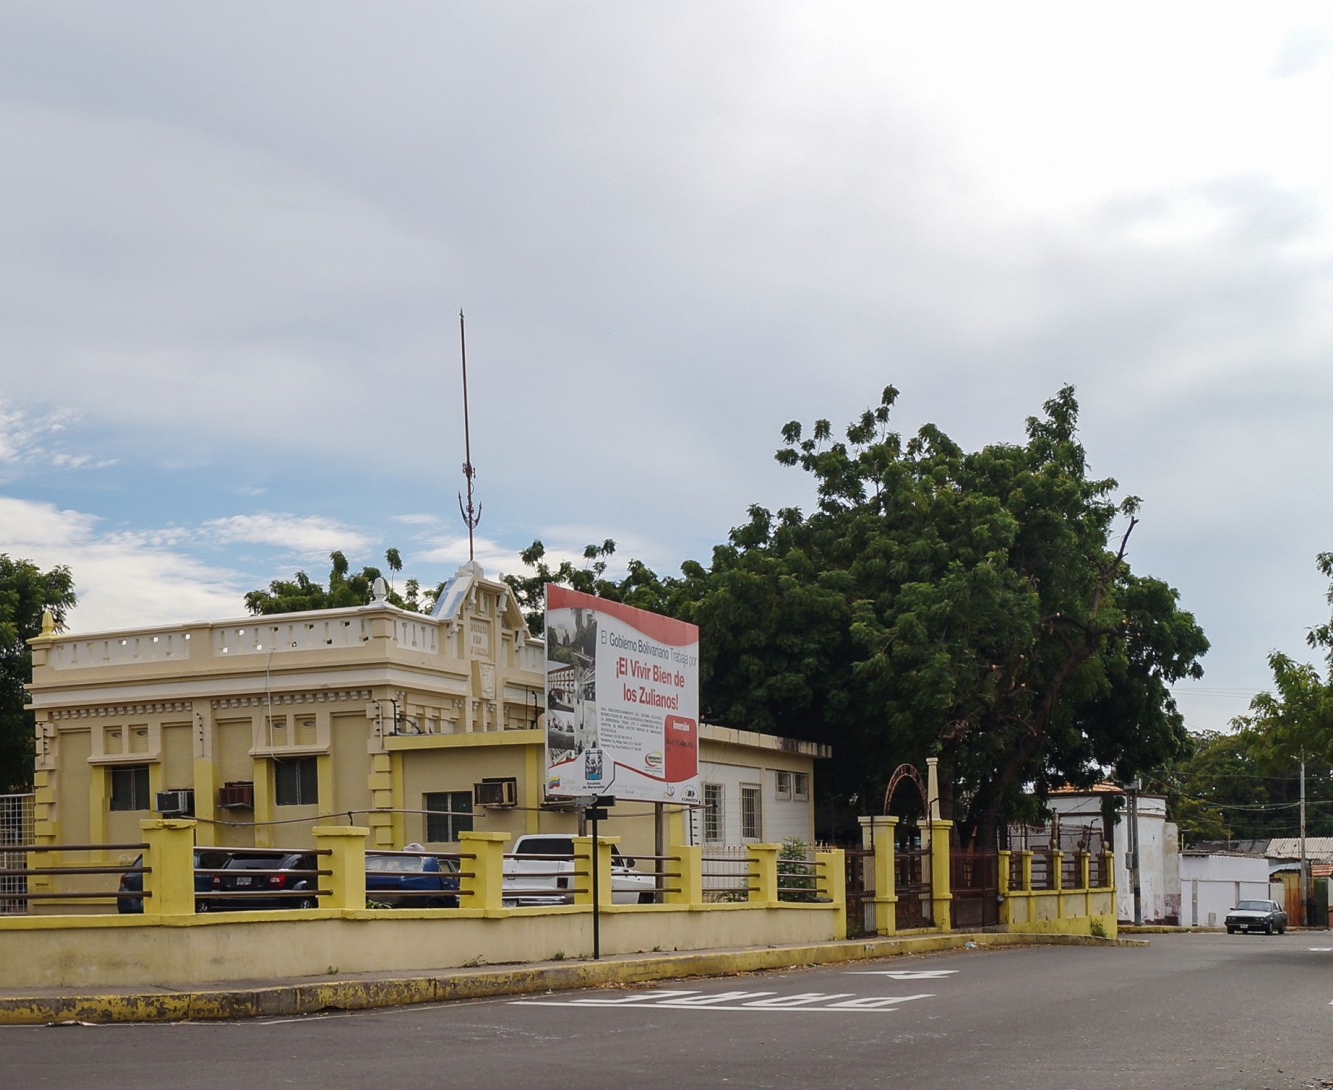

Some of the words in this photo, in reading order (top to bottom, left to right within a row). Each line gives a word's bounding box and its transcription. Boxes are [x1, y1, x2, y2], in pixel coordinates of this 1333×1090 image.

[609, 632, 637, 652] Gobierno
[638, 639, 670, 660] Bolivariano
[616, 656, 628, 679] ¡El
[629, 658, 651, 681] Vivir
[653, 664, 672, 686] Bien
[674, 670, 685, 688] de
[623, 682, 637, 703] los
[638, 686, 679, 711] Zulianos!
